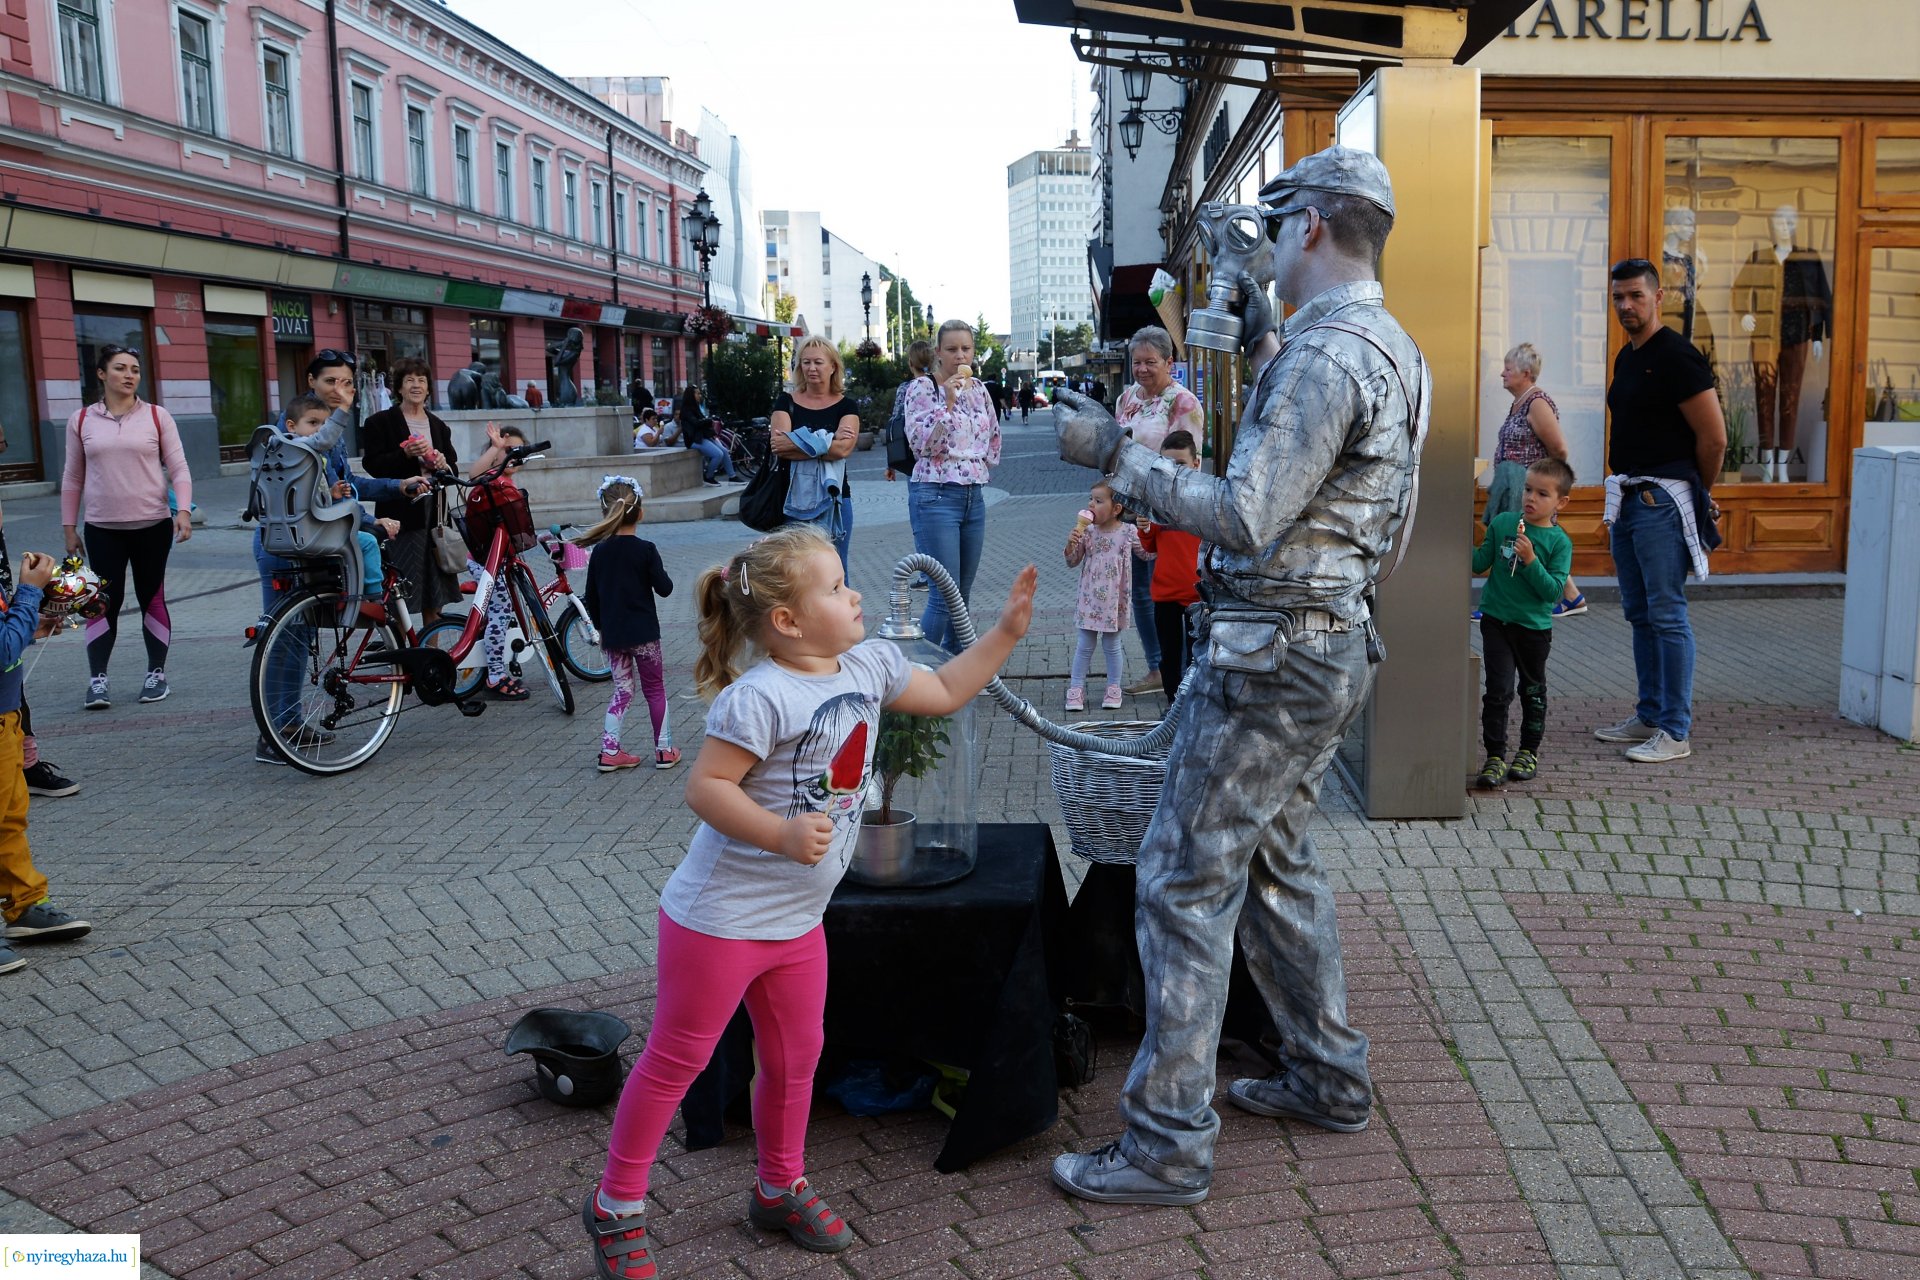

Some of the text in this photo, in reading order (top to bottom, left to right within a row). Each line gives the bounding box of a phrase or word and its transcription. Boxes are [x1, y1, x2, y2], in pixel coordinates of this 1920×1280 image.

[1502, 0, 1772, 42] ARELLA
[272, 300, 308, 318] ANGOL
[272, 316, 309, 335] DIVAT
